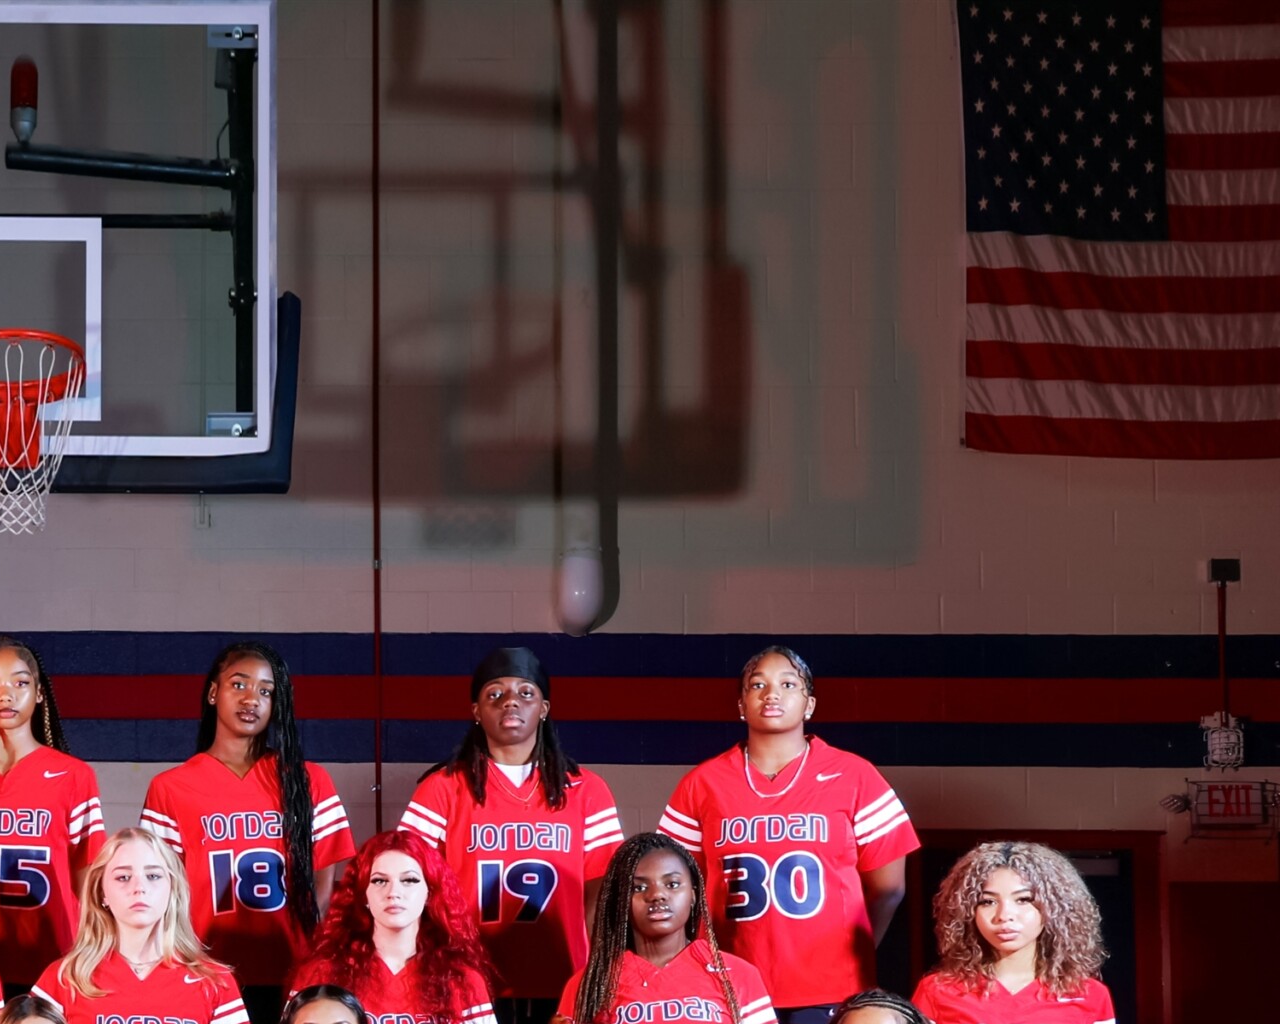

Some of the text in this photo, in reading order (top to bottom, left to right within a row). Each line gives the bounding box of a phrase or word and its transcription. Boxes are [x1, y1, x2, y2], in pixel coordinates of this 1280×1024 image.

[1207, 784, 1253, 818] EXIT
[207, 847, 287, 916] 18
[477, 858, 559, 925] 19
[722, 849, 826, 922] 30
